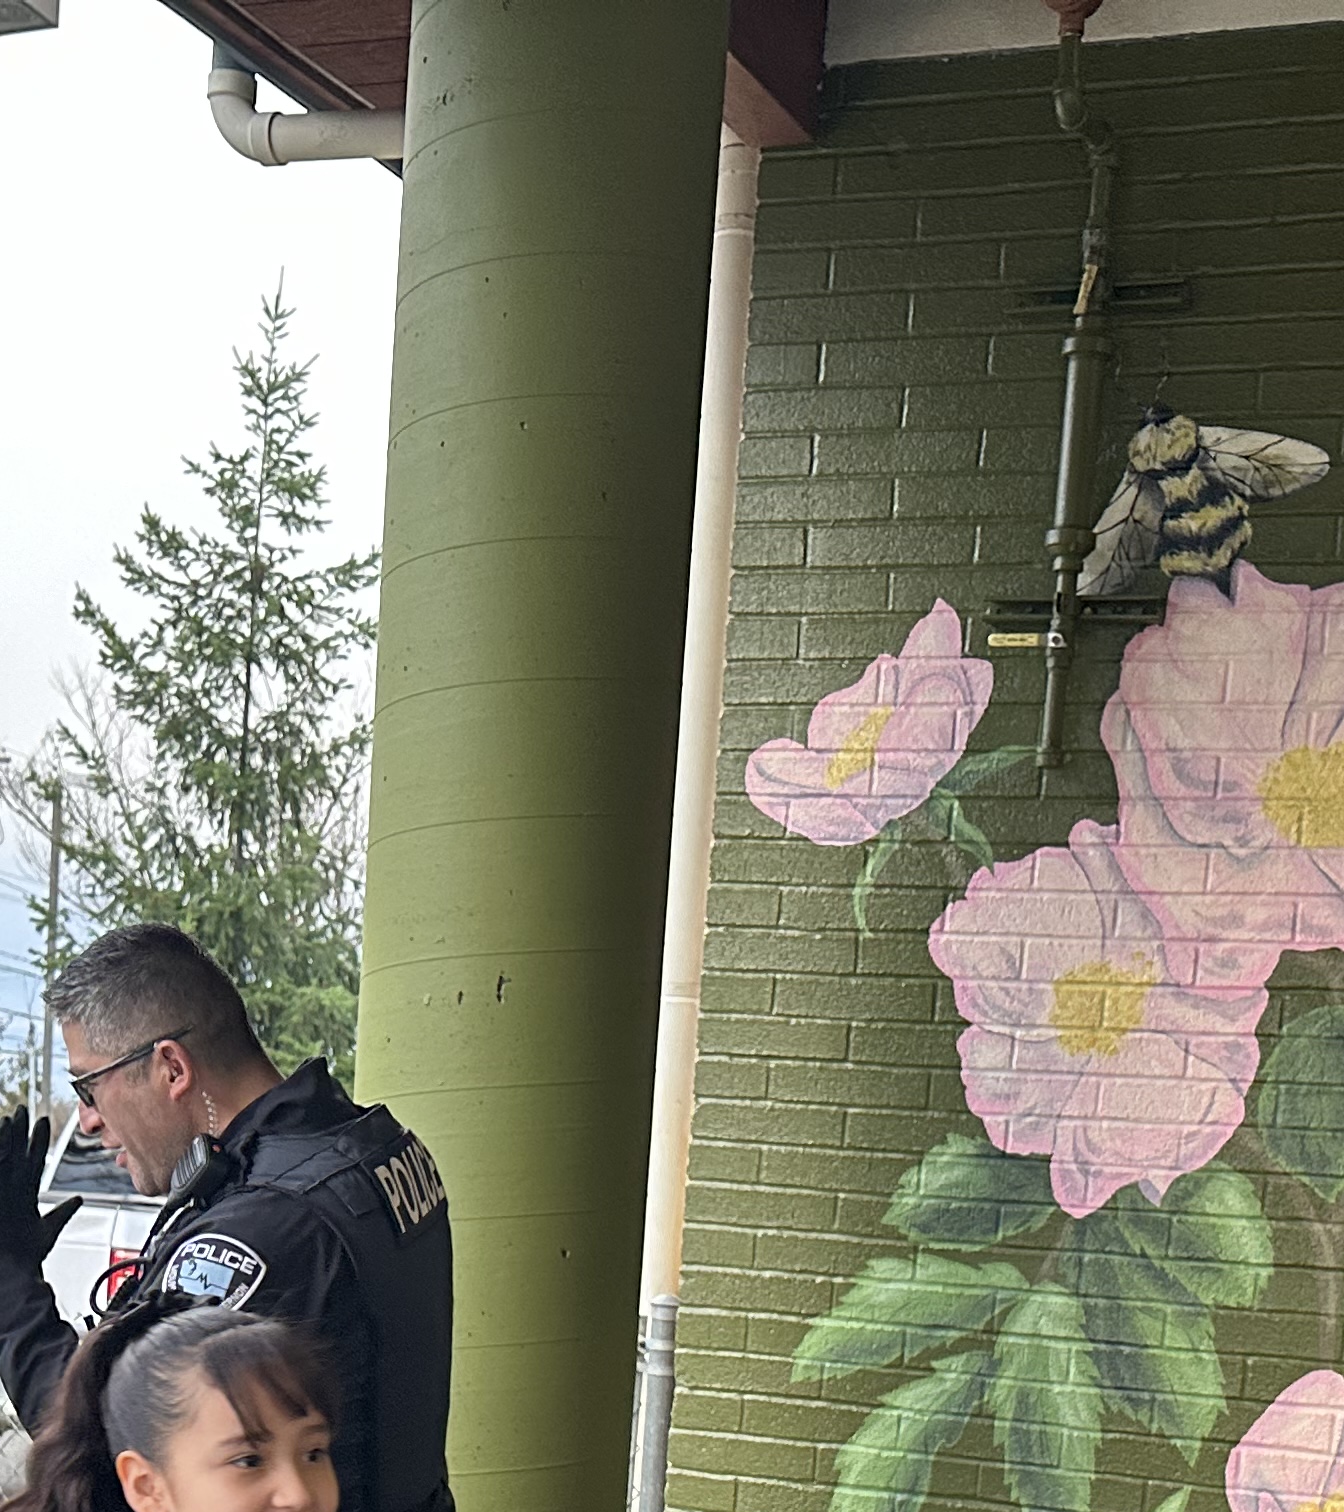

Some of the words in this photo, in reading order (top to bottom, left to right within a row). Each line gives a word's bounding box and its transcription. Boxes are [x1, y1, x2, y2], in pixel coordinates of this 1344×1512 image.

[374, 1136, 446, 1233] POLICE
[180, 1242, 258, 1275] POLICE
[221, 1282, 249, 1310] ERNON
